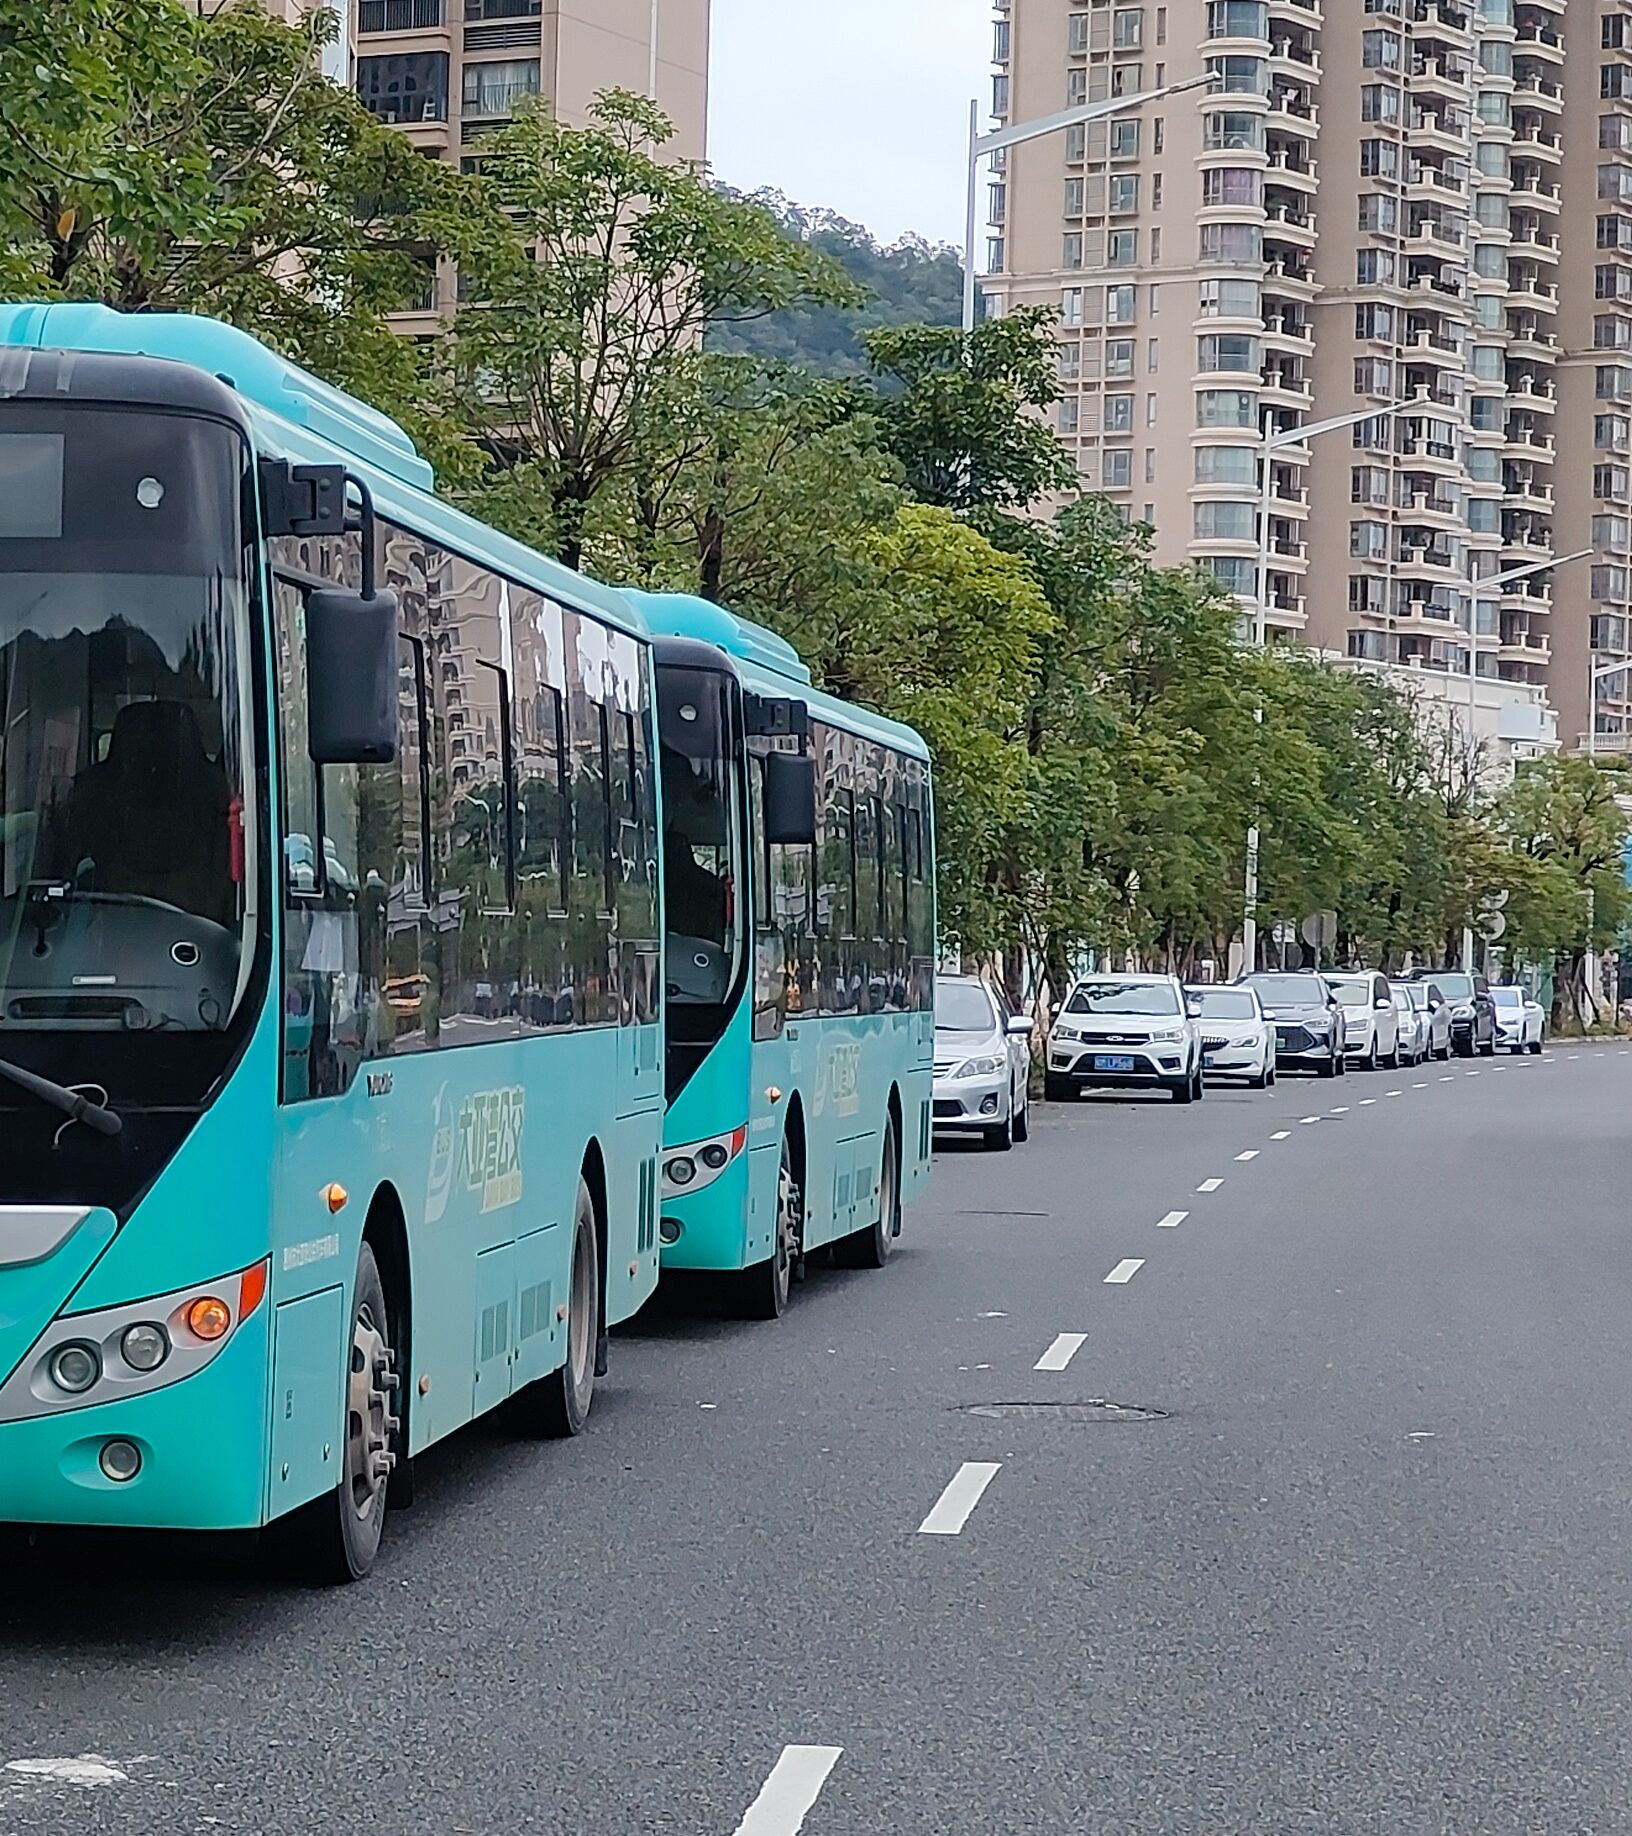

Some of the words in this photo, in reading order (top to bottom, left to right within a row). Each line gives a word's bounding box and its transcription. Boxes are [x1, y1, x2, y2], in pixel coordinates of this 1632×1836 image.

[457, 1087, 523, 1194] 大亚湾公交
